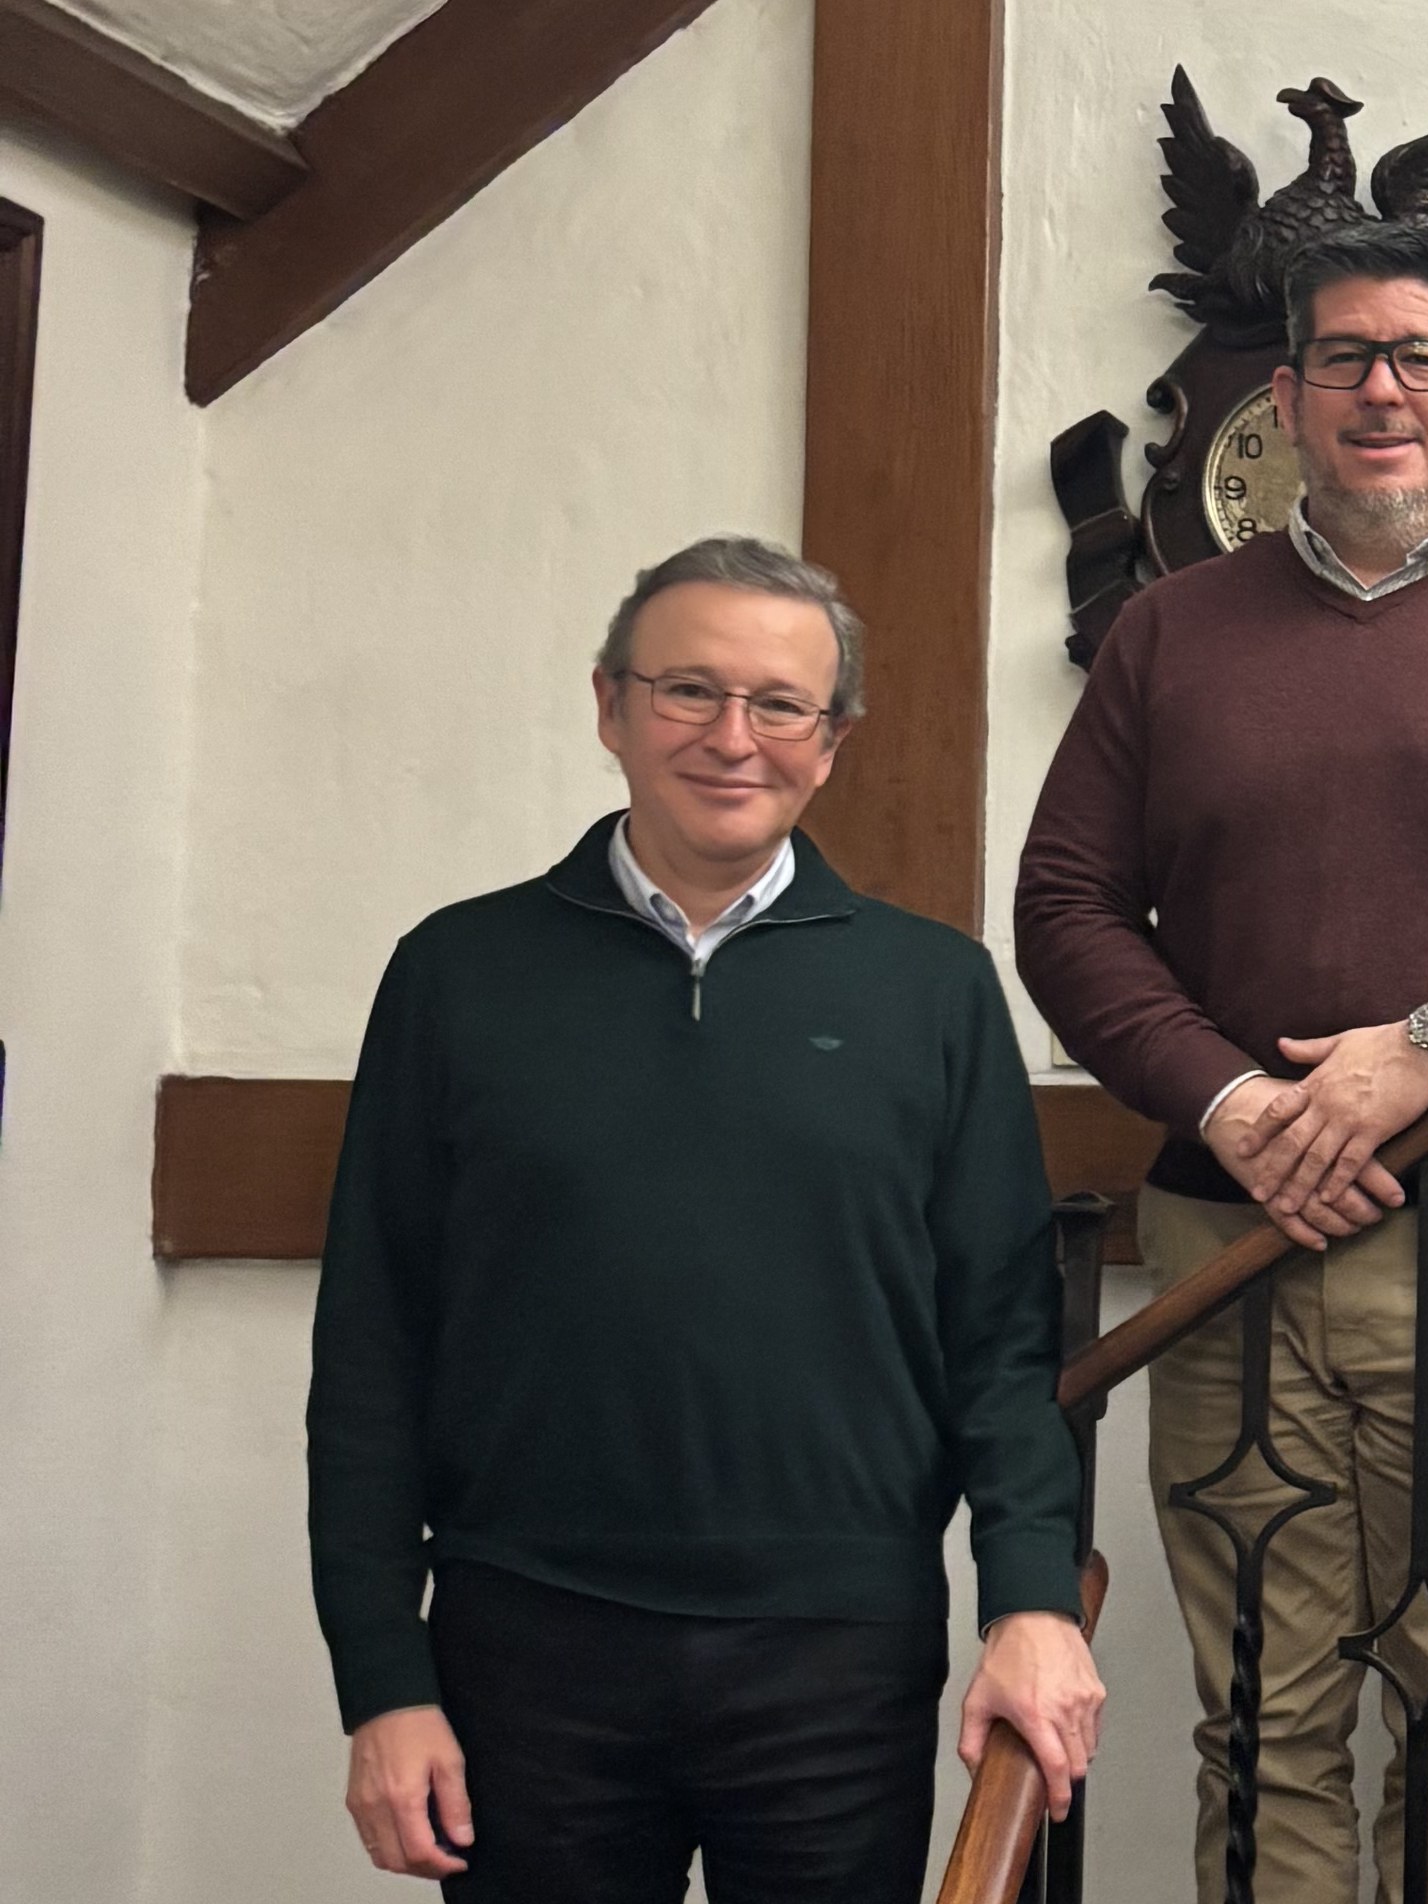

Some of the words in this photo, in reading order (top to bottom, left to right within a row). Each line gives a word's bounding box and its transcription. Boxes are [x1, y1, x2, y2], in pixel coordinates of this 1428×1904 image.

[1237, 433, 1263, 459] 10
[1224, 475, 1247, 500] 9
[1236, 517, 1258, 542] 8
